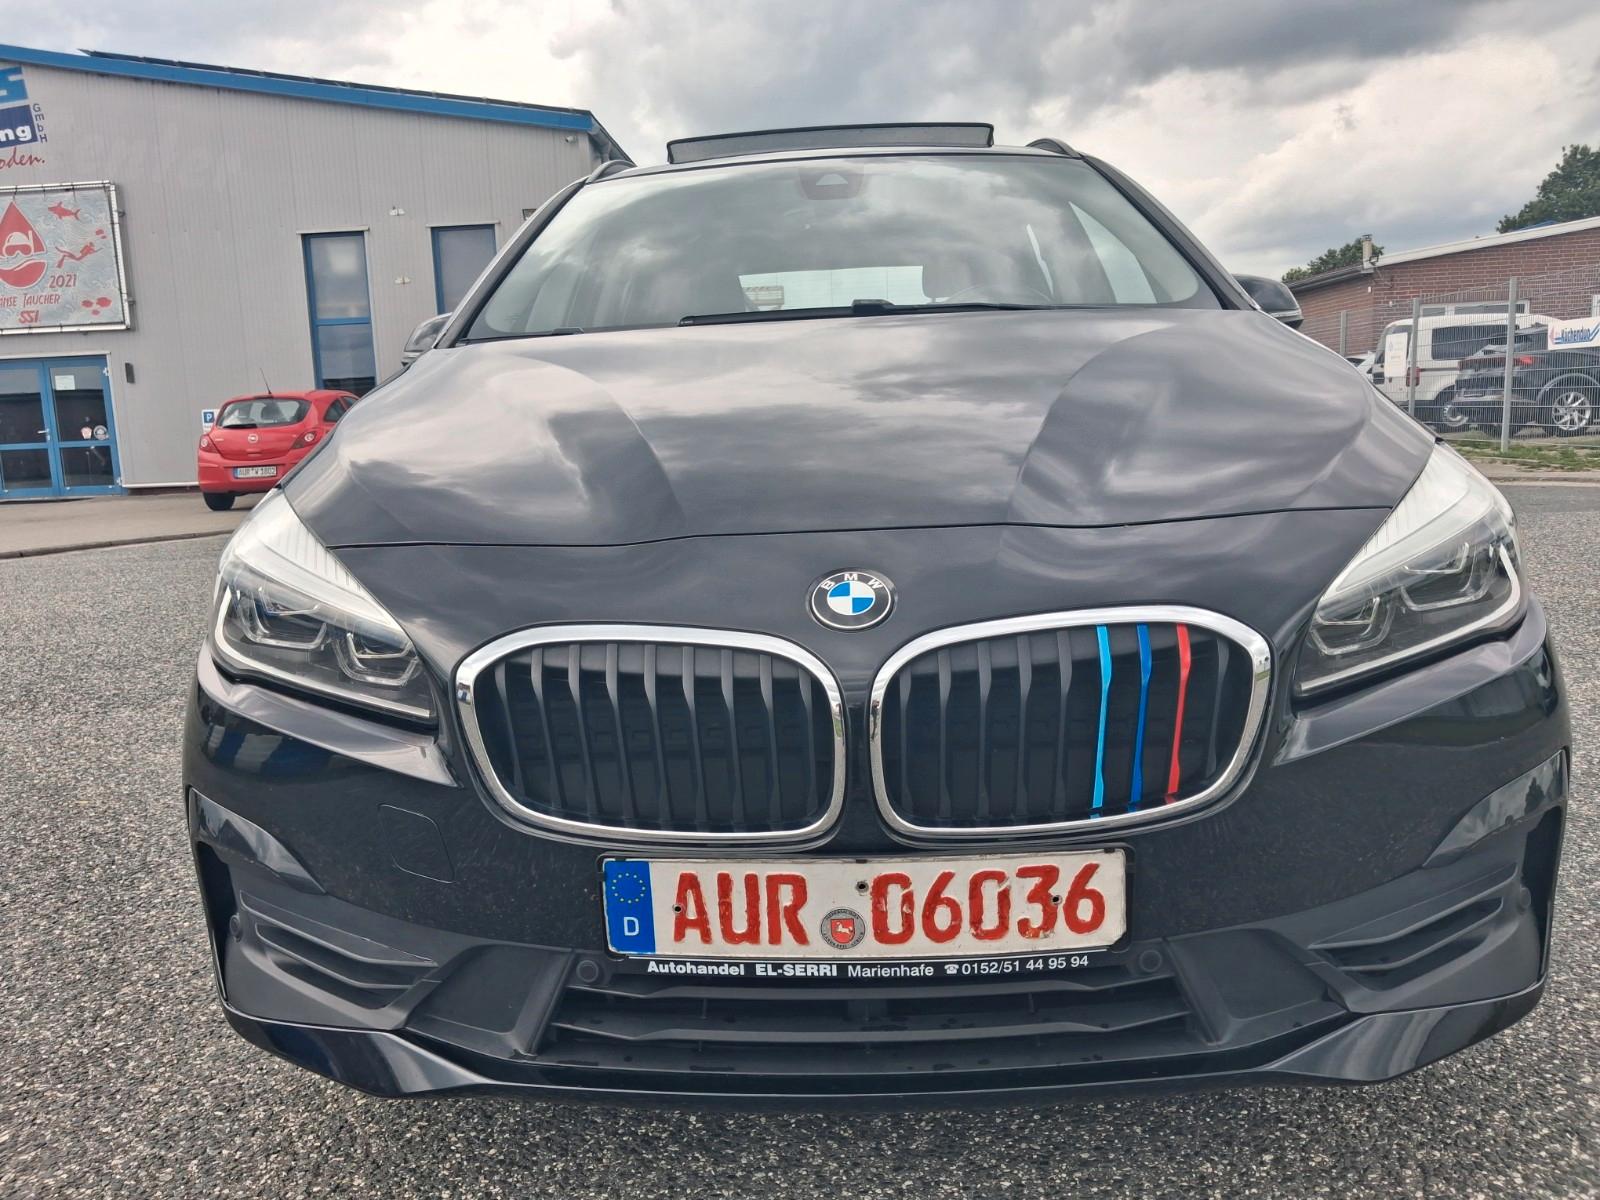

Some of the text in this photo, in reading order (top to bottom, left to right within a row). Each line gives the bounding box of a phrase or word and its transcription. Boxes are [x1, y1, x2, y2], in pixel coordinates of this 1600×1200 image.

[32, 103, 48, 144] GmbH
[49, 273, 77, 289] 2021
[23, 293, 61, 308] TAUCHER
[19, 310, 39, 324] SSI
[820, 573, 883, 590] BMW
[674, 863, 1106, 945] AUR 06036
[624, 916, 640, 936] D
[647, 955, 1089, 977] Autohandel EL-SERRI Marienhafe 0152/51 44 95 94
